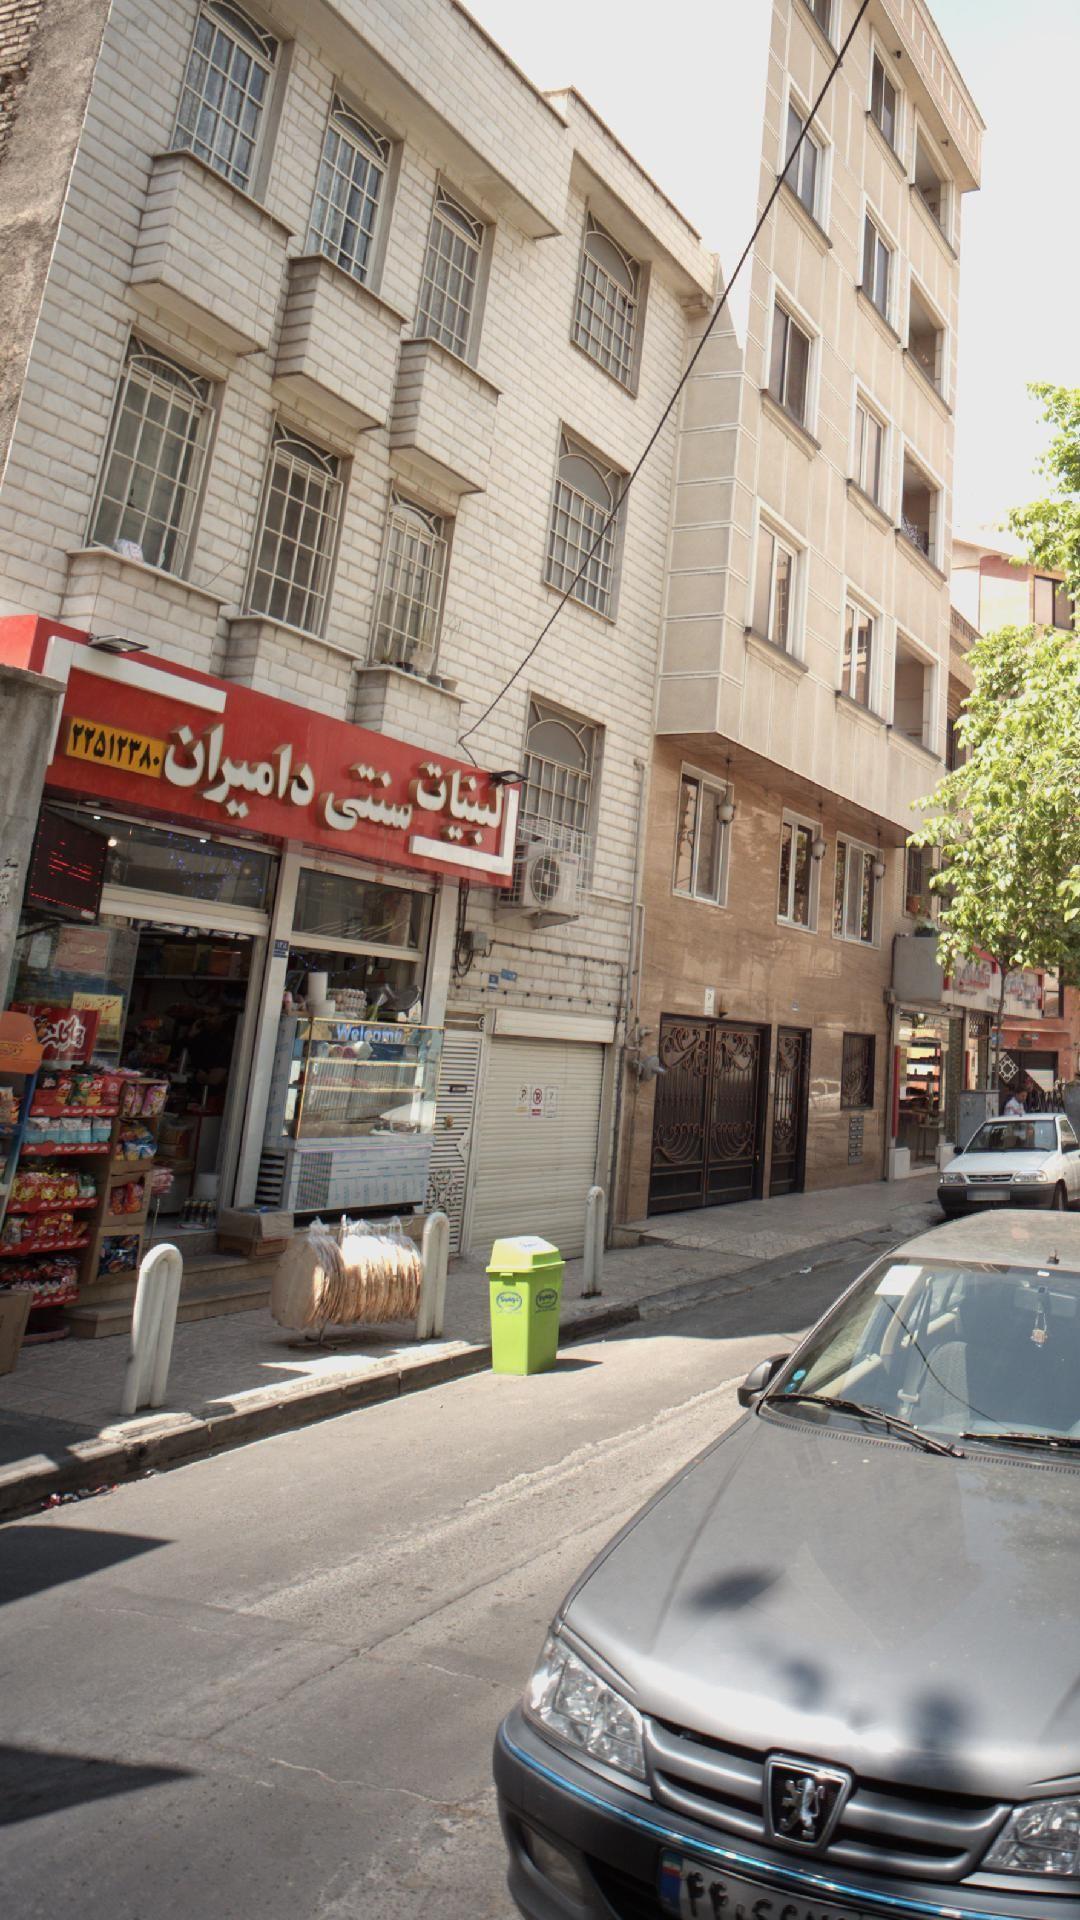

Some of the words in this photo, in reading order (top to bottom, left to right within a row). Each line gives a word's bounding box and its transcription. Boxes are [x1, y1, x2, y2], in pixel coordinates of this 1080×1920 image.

[72, 722, 160, 770] ۲۲۵۱۲۳۸۰
[165, 724, 315, 819] دامیران
[323, 763, 413, 832] سنتی
[412, 762, 504, 846] لبنیات
[336, 1022, 405, 1044] Welcome
